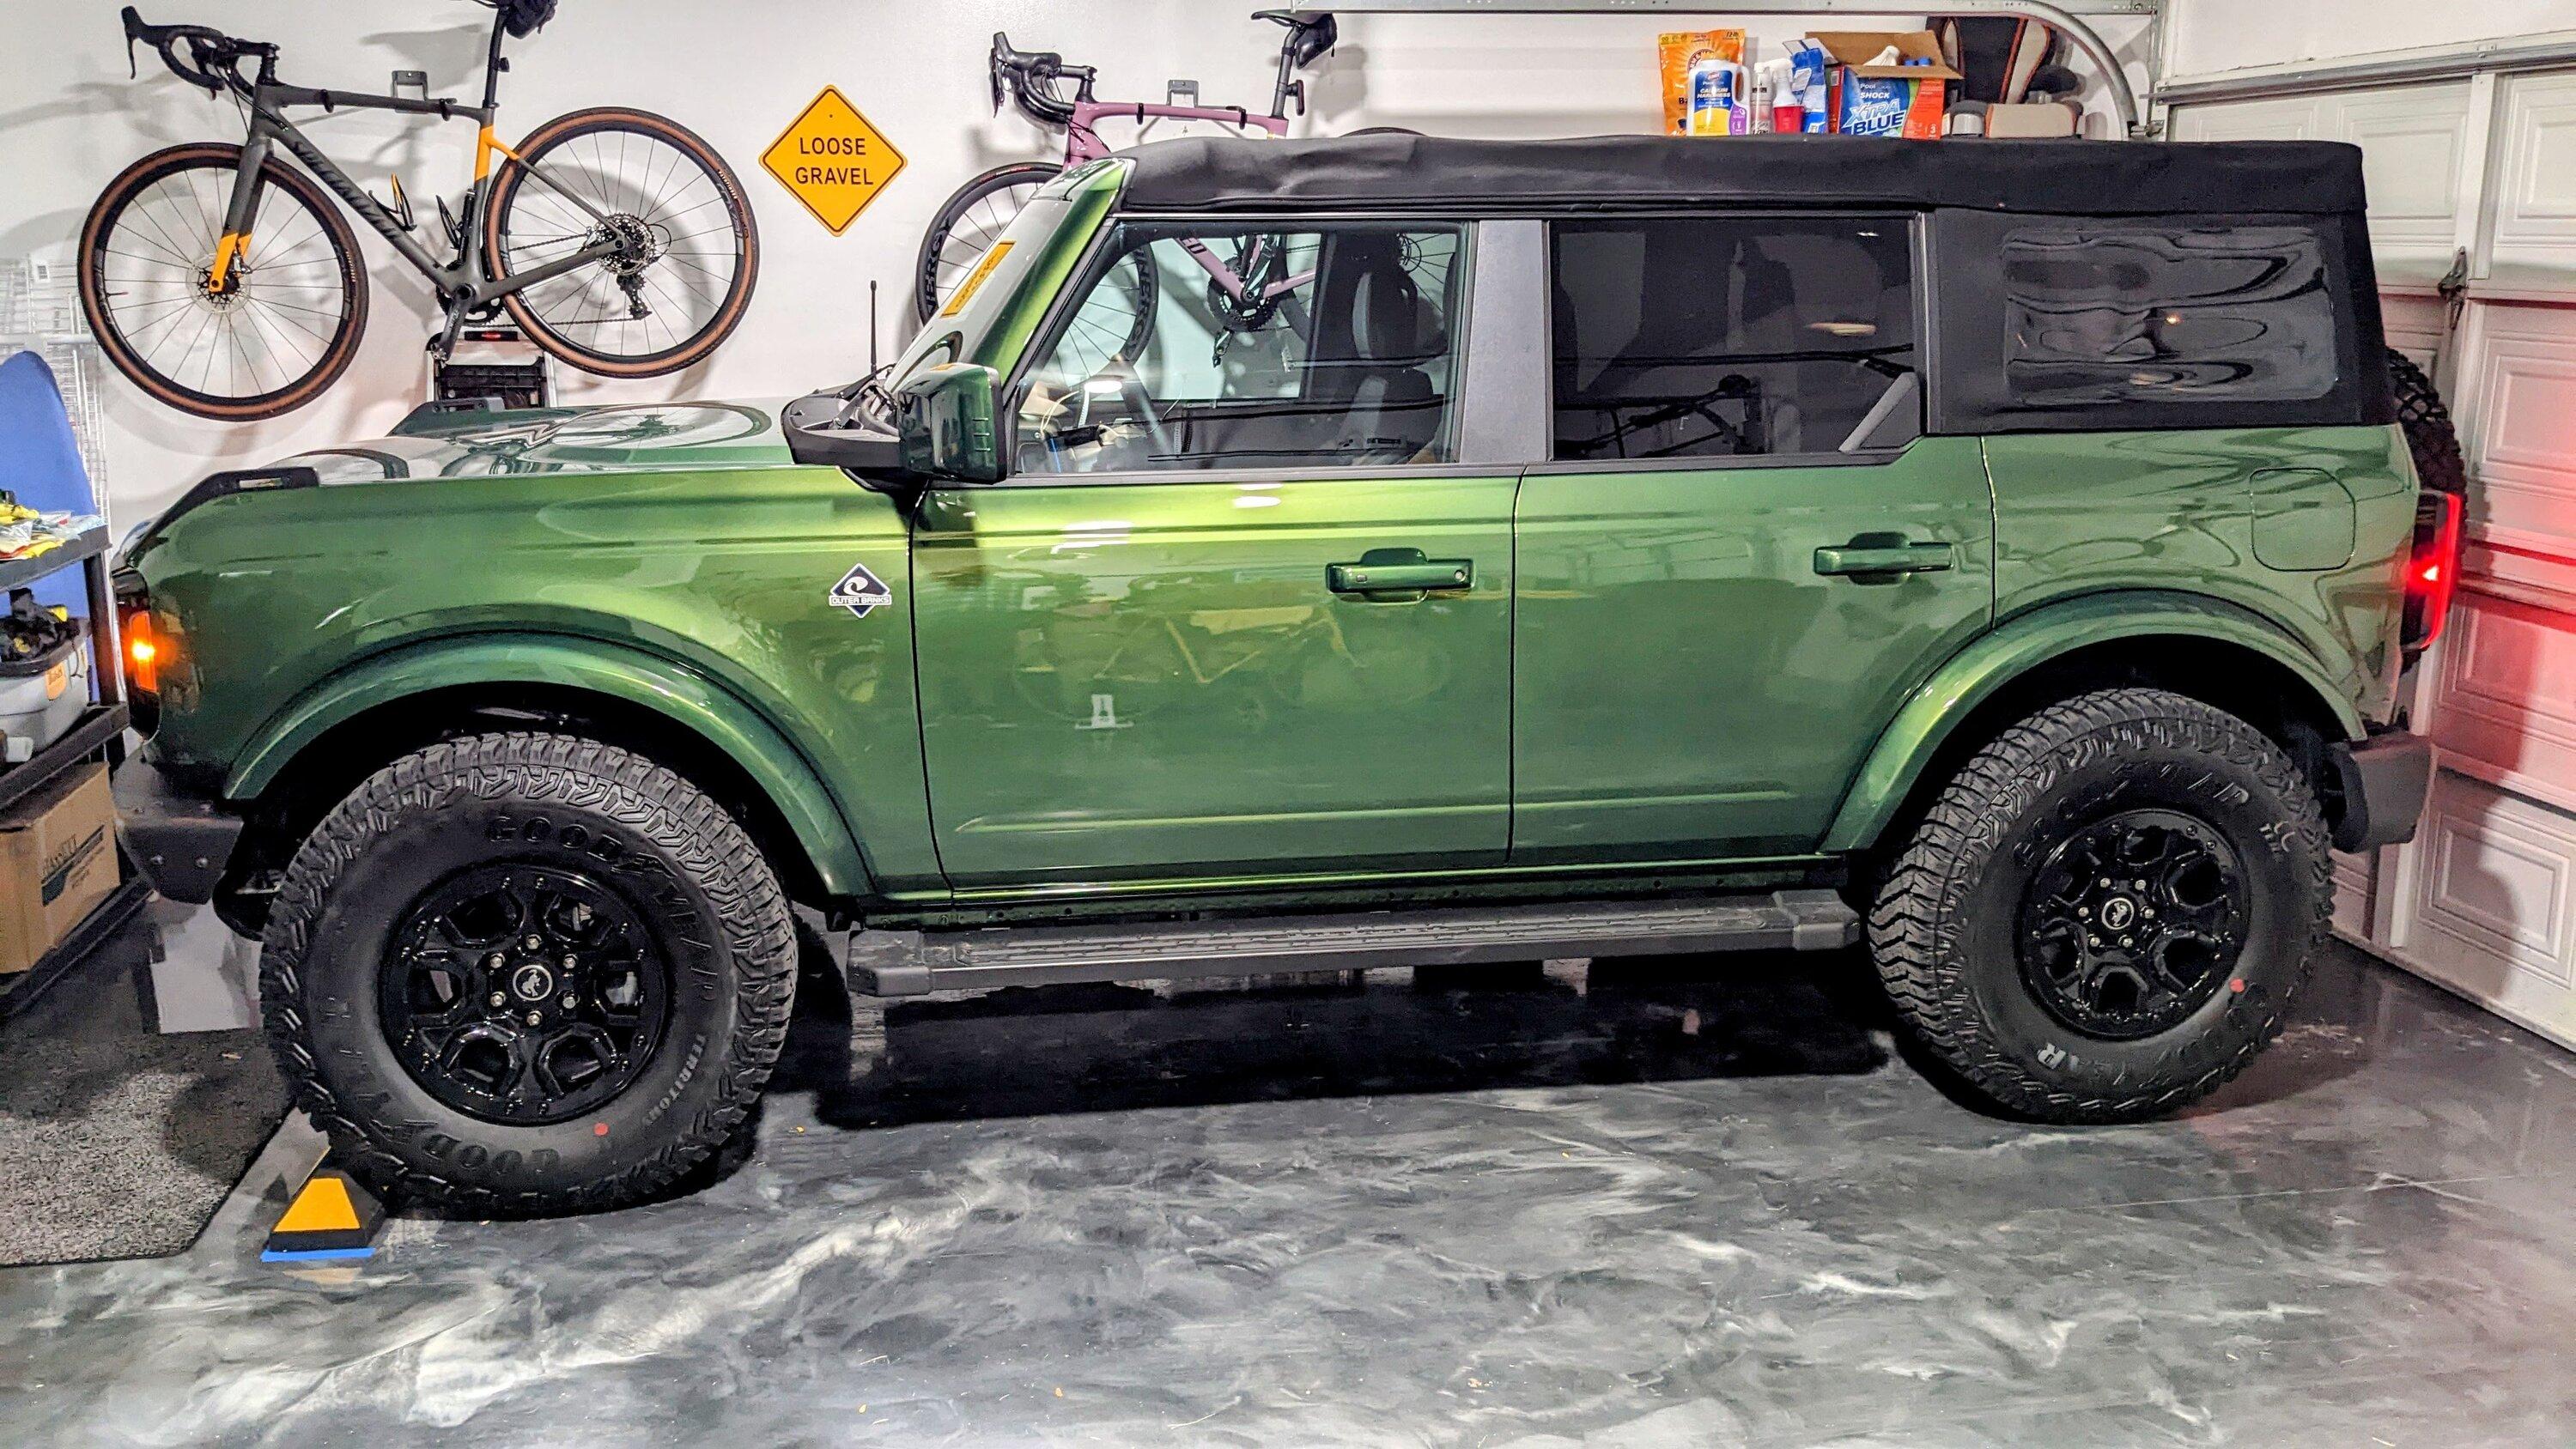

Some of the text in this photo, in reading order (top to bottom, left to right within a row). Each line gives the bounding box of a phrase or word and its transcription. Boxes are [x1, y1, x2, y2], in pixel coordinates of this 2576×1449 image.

[1841, 98, 1900, 129] XTRA
[1851, 110, 1906, 135] BLUE
[799, 137, 866, 155] LOOSE
[795, 167, 874, 185] GRAVEL
